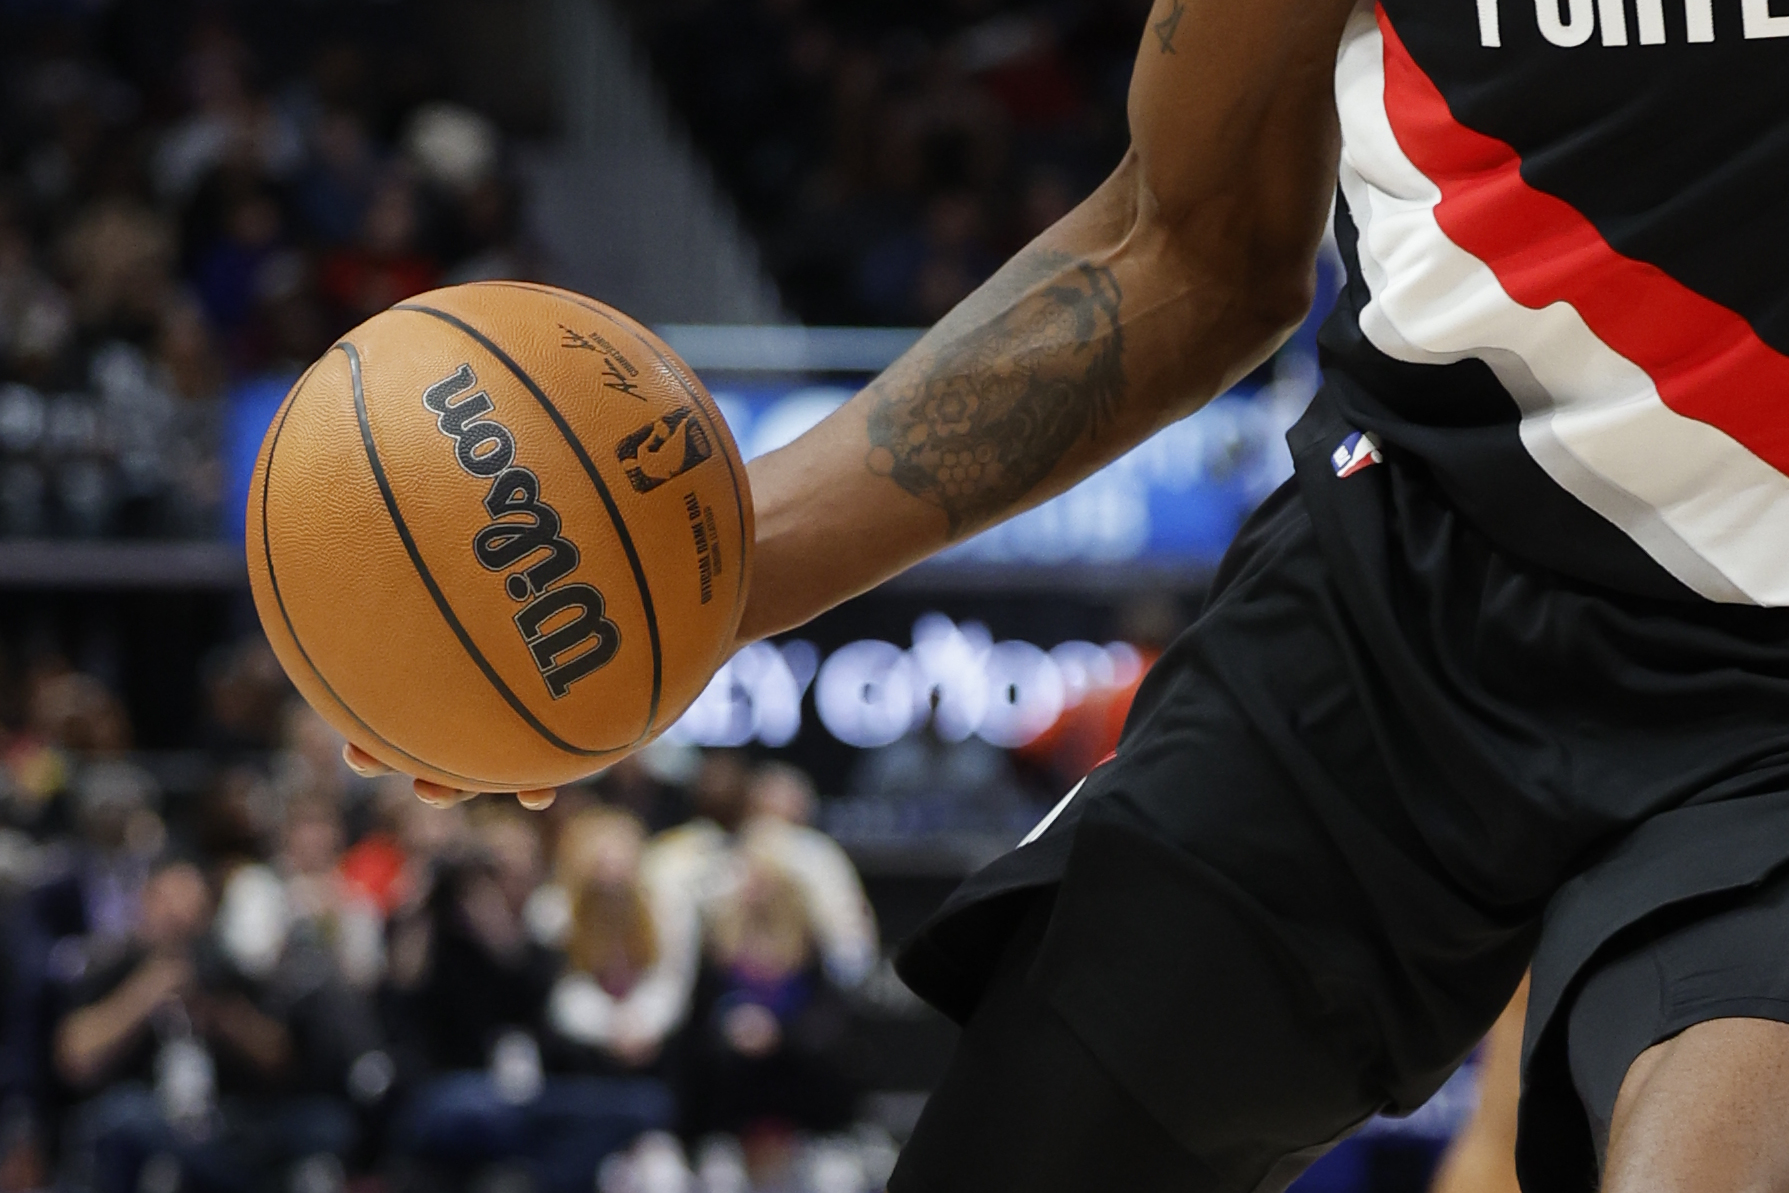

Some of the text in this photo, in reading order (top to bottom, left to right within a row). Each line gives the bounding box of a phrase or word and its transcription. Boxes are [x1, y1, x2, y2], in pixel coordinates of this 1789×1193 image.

[423, 364, 620, 699] Wilson
[683, 491, 713, 605] OFFICIAL GAME BALL
